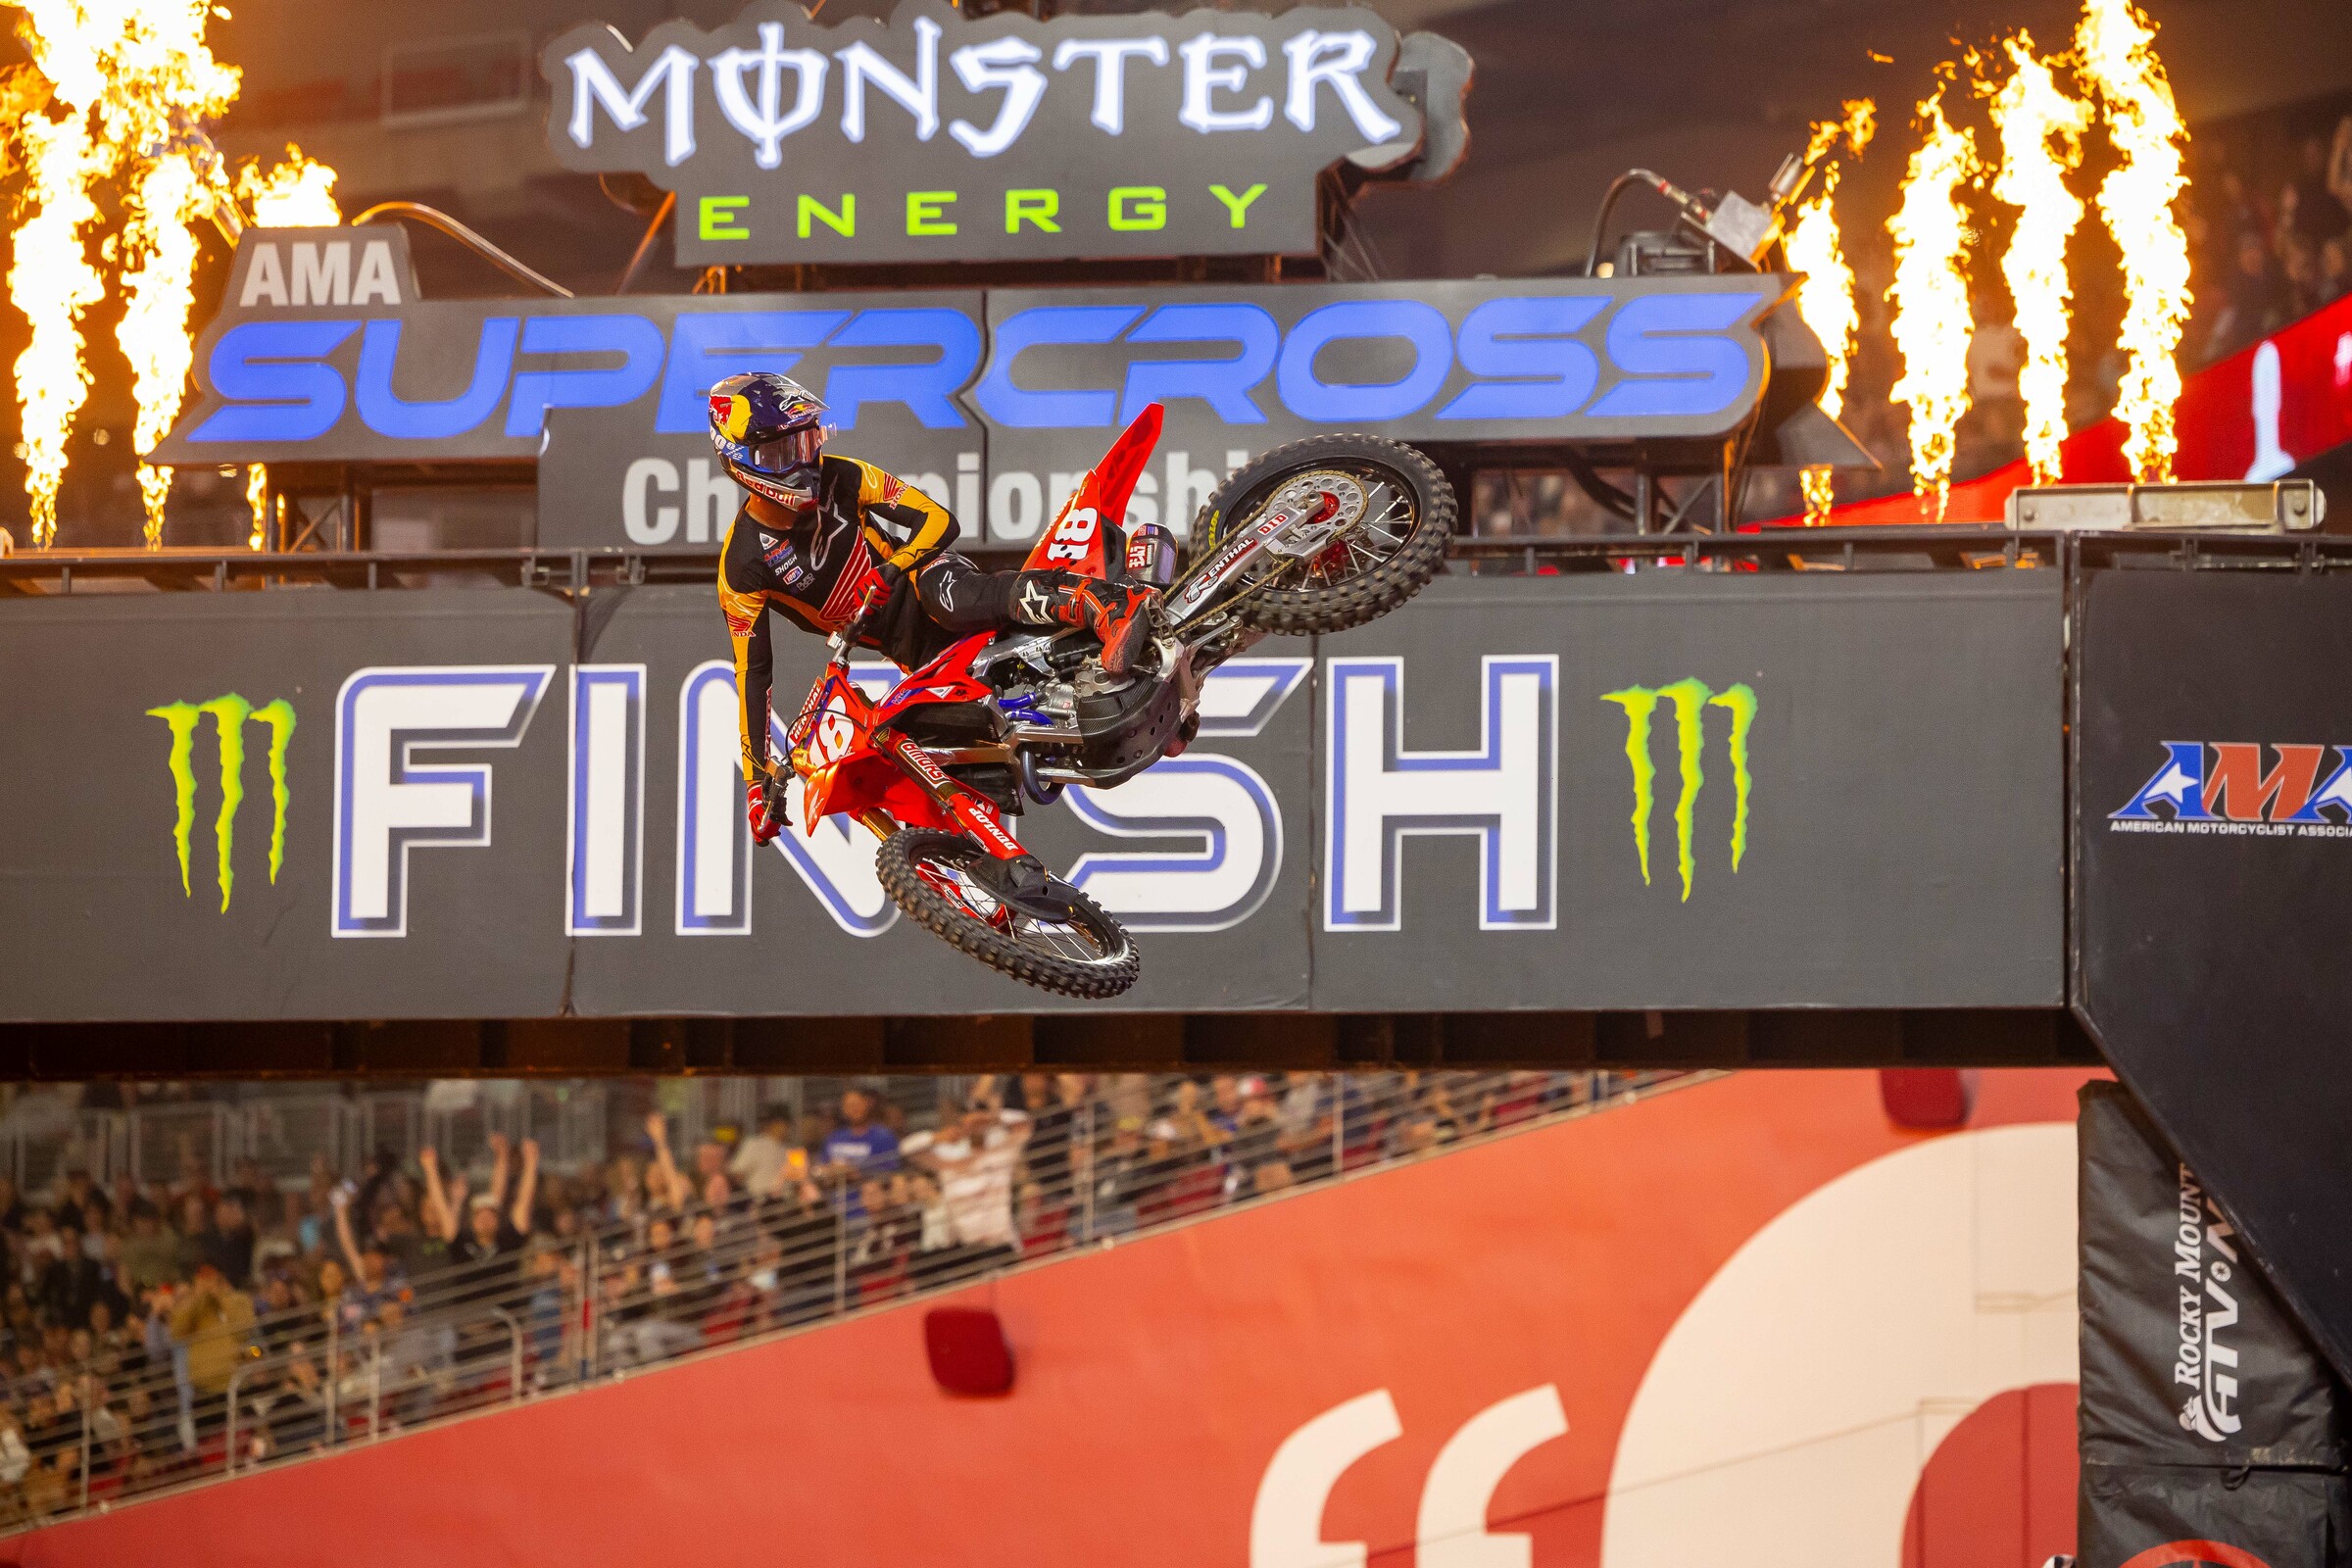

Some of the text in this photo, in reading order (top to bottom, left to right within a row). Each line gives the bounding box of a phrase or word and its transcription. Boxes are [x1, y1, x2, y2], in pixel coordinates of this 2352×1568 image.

[565, 17, 1401, 168] MONSTER
[698, 183, 1267, 241] ENERGY
[239, 241, 401, 307] AMA
[186, 292, 1764, 442] SUPERCROSS
[622, 450, 1250, 545] Chiosh
[736, 471, 795, 508] Red Bull
[1047, 507, 1098, 561] 18
[1258, 514, 1288, 535] DID
[794, 685, 821, 740] RENTHAL
[901, 742, 947, 781] SHOWA
[331, 654, 1560, 938] FINSH
[968, 808, 1018, 851] DUNLOP
[2111, 820, 2184, 834] AMERICAN
[2187, 821, 2294, 837] MOTORCYCLIST
[2175, 1285, 2201, 1391] ROCKY
